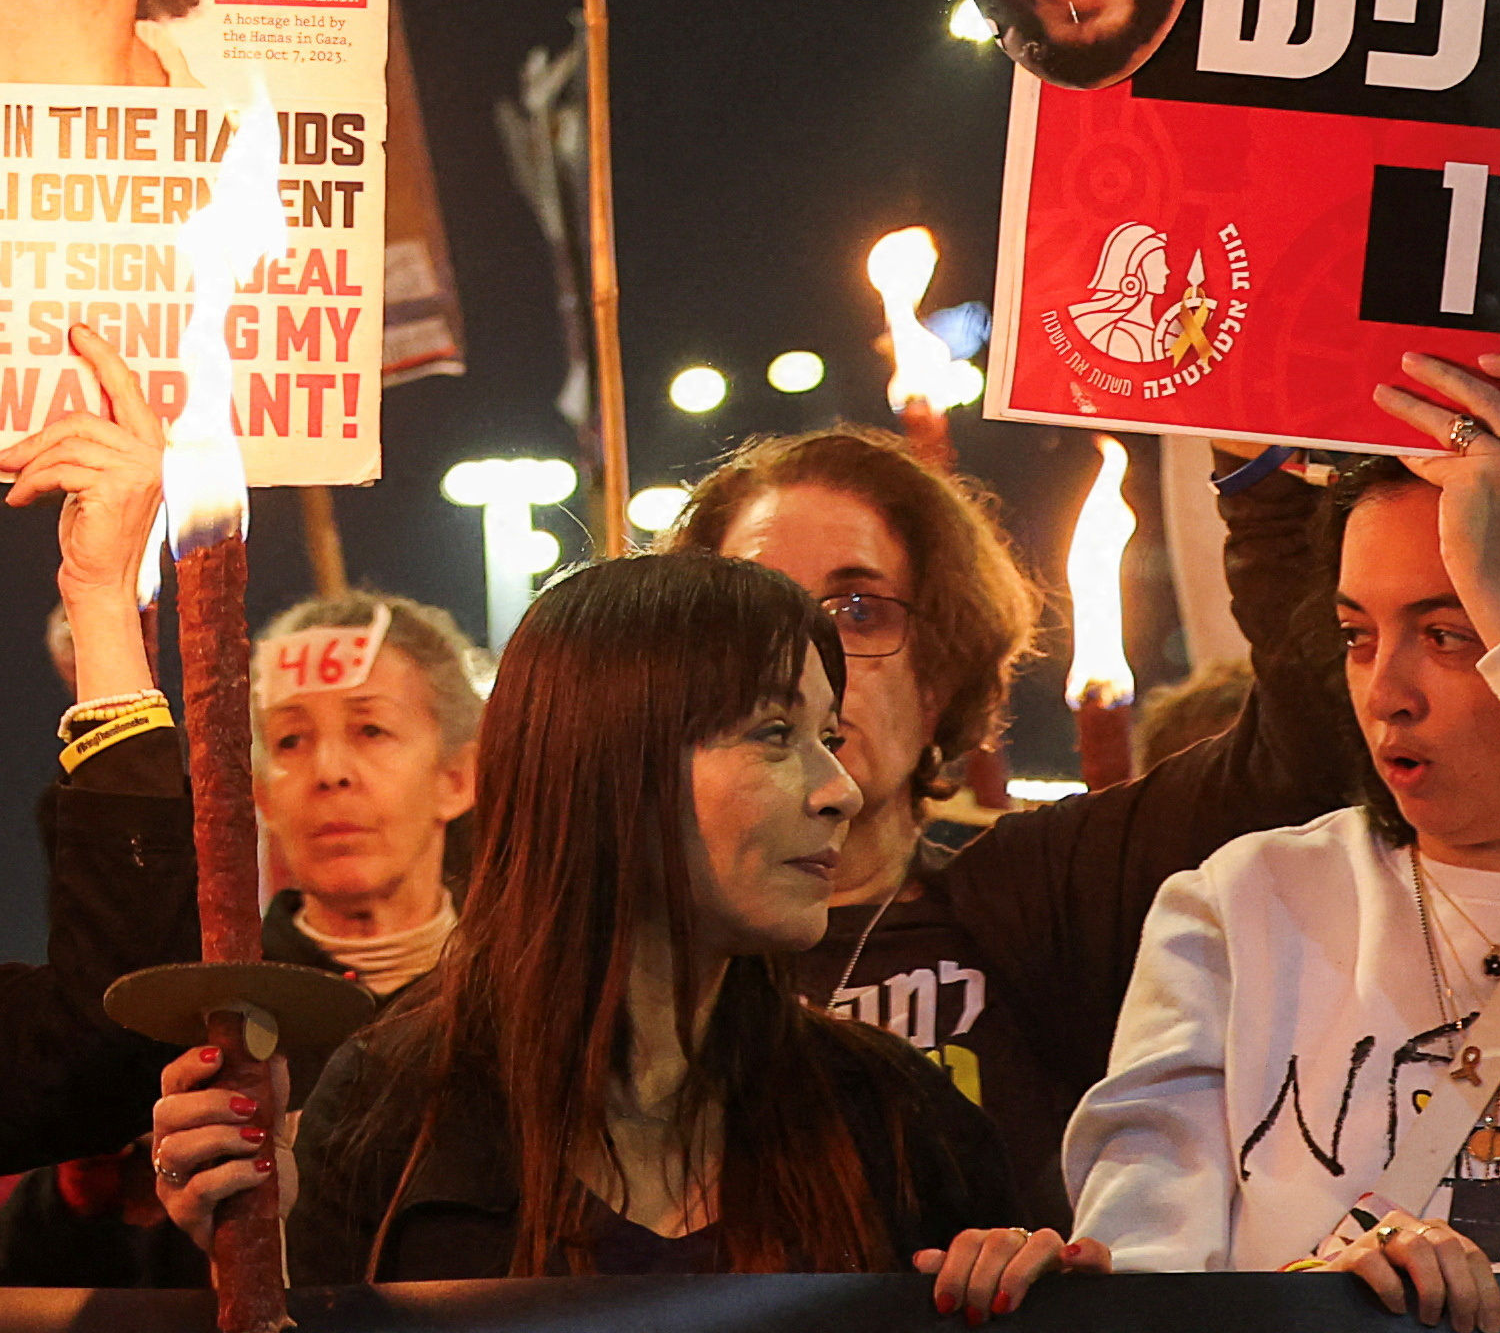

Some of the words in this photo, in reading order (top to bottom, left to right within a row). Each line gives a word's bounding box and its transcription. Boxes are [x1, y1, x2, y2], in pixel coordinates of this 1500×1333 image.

[223, 13, 232, 25] A
[236, 13, 290, 29] hostage
[295, 15, 325, 28] held
[330, 16, 346, 31] by
[223, 31, 246, 42] the
[250, 32, 292, 44] Hamas
[297, 32, 313, 44] in
[316, 34, 352, 47] Gaza,
[223, 47, 262, 60] since
[265, 49, 288, 60] Oct
[292, 50, 305, 63] 7,
[309, 50, 347, 64] 2023.
[4, 104, 33, 158] IN
[49, 106, 158, 161] THE
[173, 108, 365, 167] HDS
[31, 173, 364, 229] GOVERENT
[65, 242, 177, 293] SIGN
[1218, 222, 1250, 290] בונות
[28, 300, 260, 361] SIGNIG
[276, 305, 361, 363] MY
[1041, 309, 1072, 355] השטח
[1065, 351, 1090, 376] את
[1088, 367, 1132, 397] משנות
